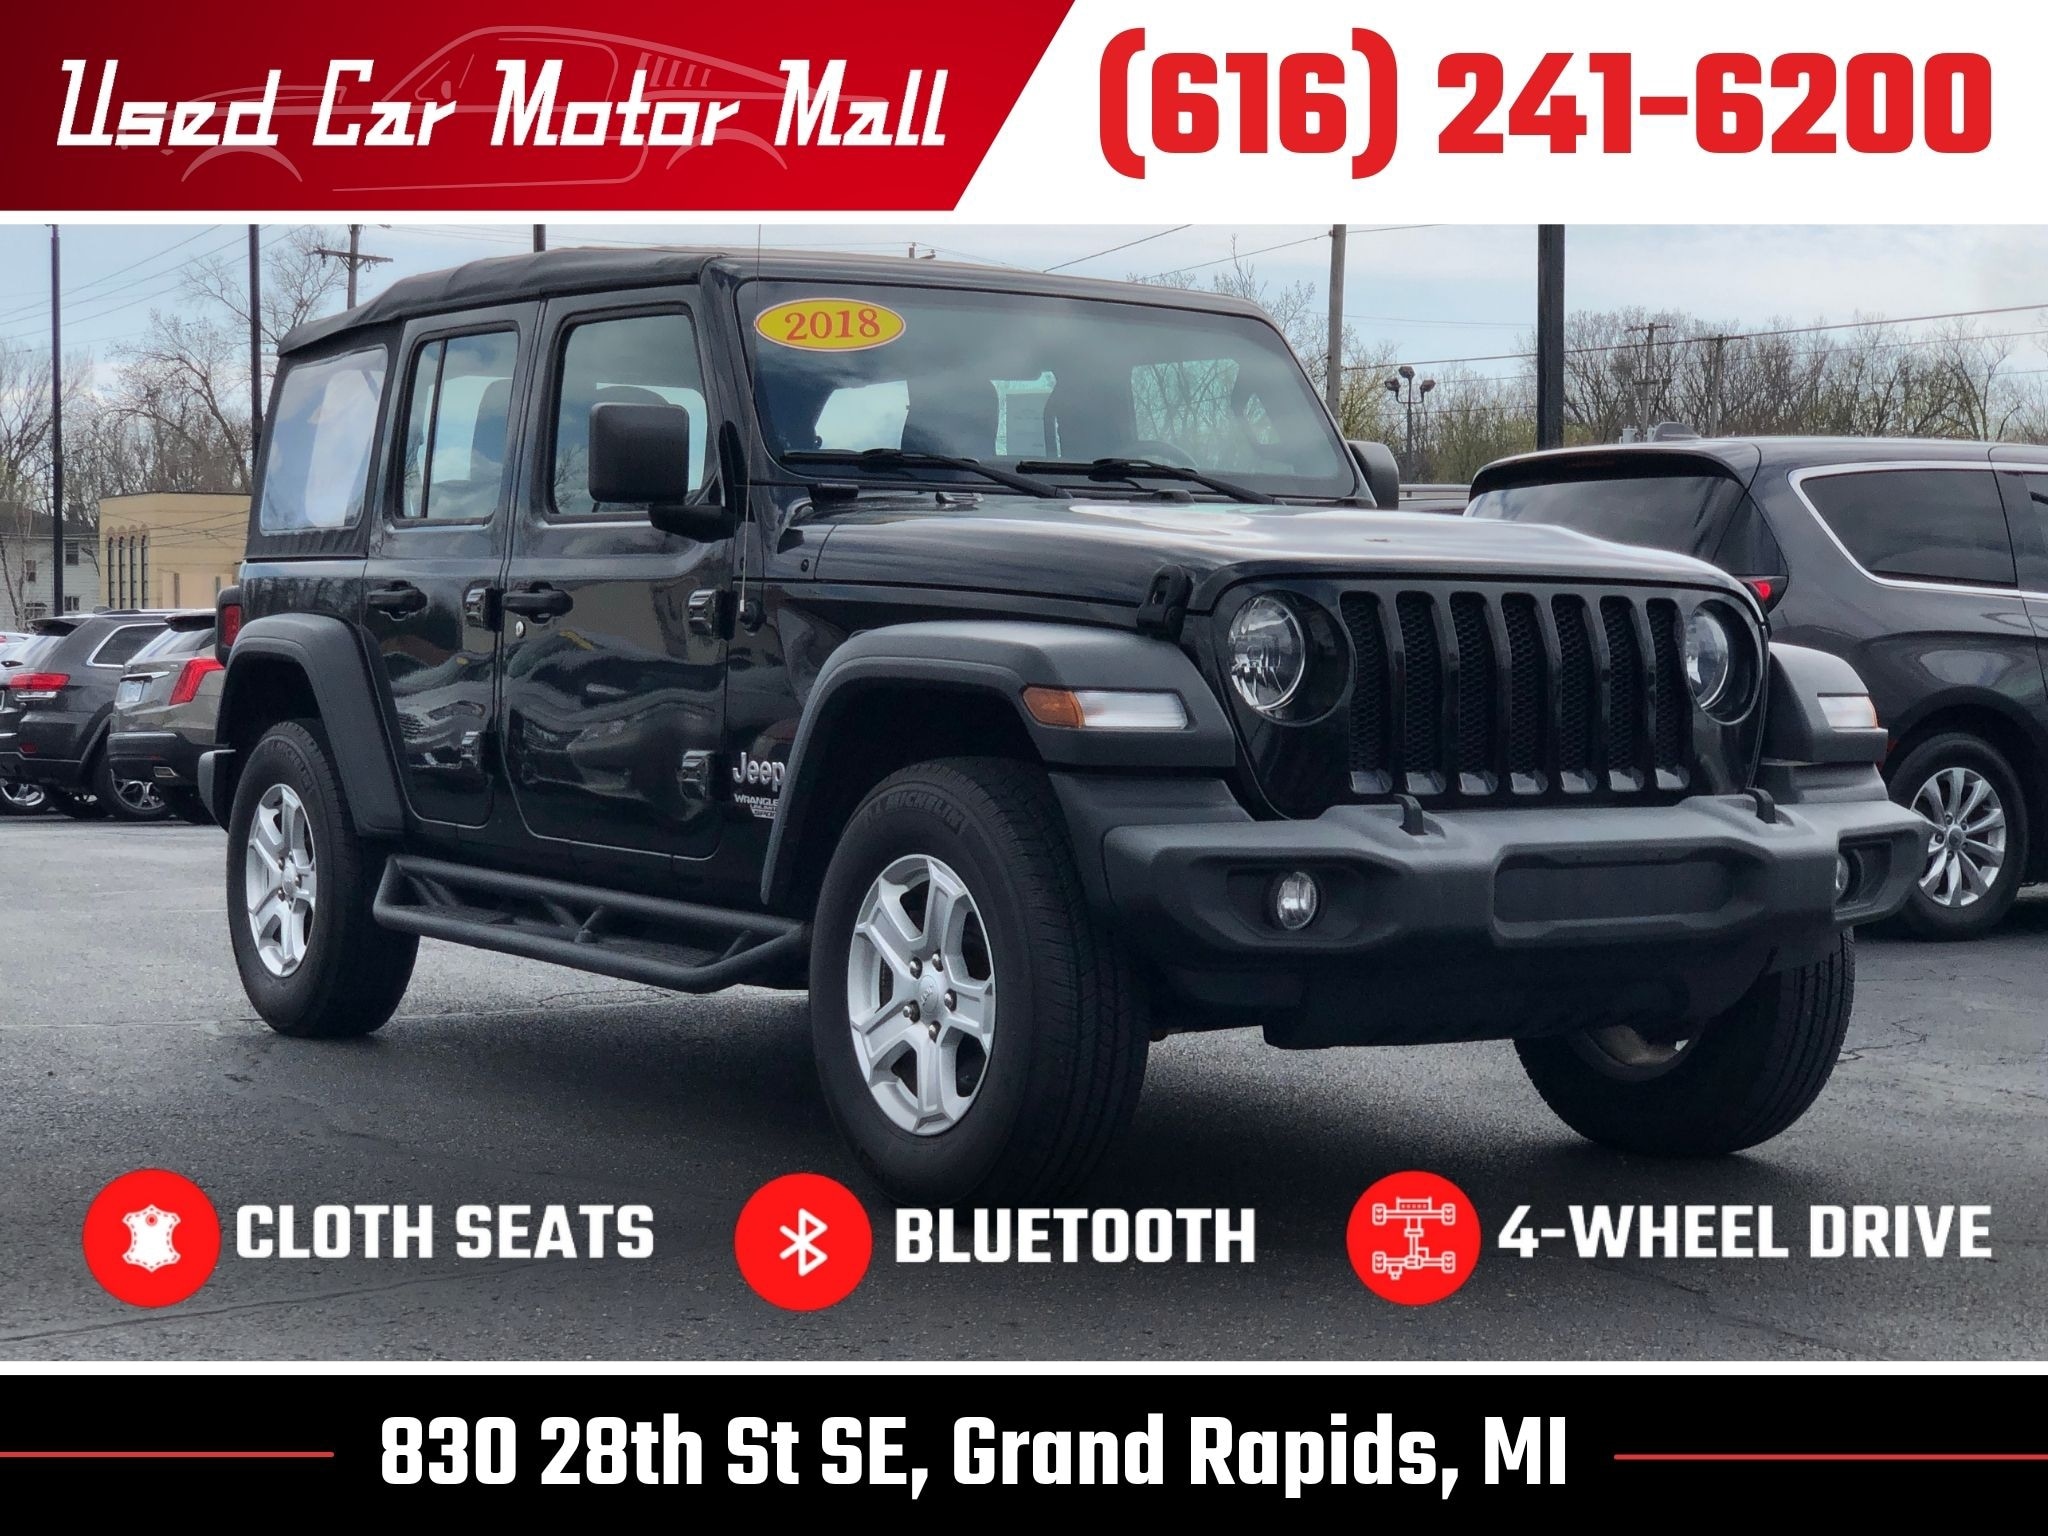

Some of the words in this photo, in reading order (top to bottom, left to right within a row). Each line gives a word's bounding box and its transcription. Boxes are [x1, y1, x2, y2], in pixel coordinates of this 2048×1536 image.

[784, 308, 881, 341] 2018
[732, 751, 786, 792] Jeep
[733, 792, 780, 807] WRANGLE
